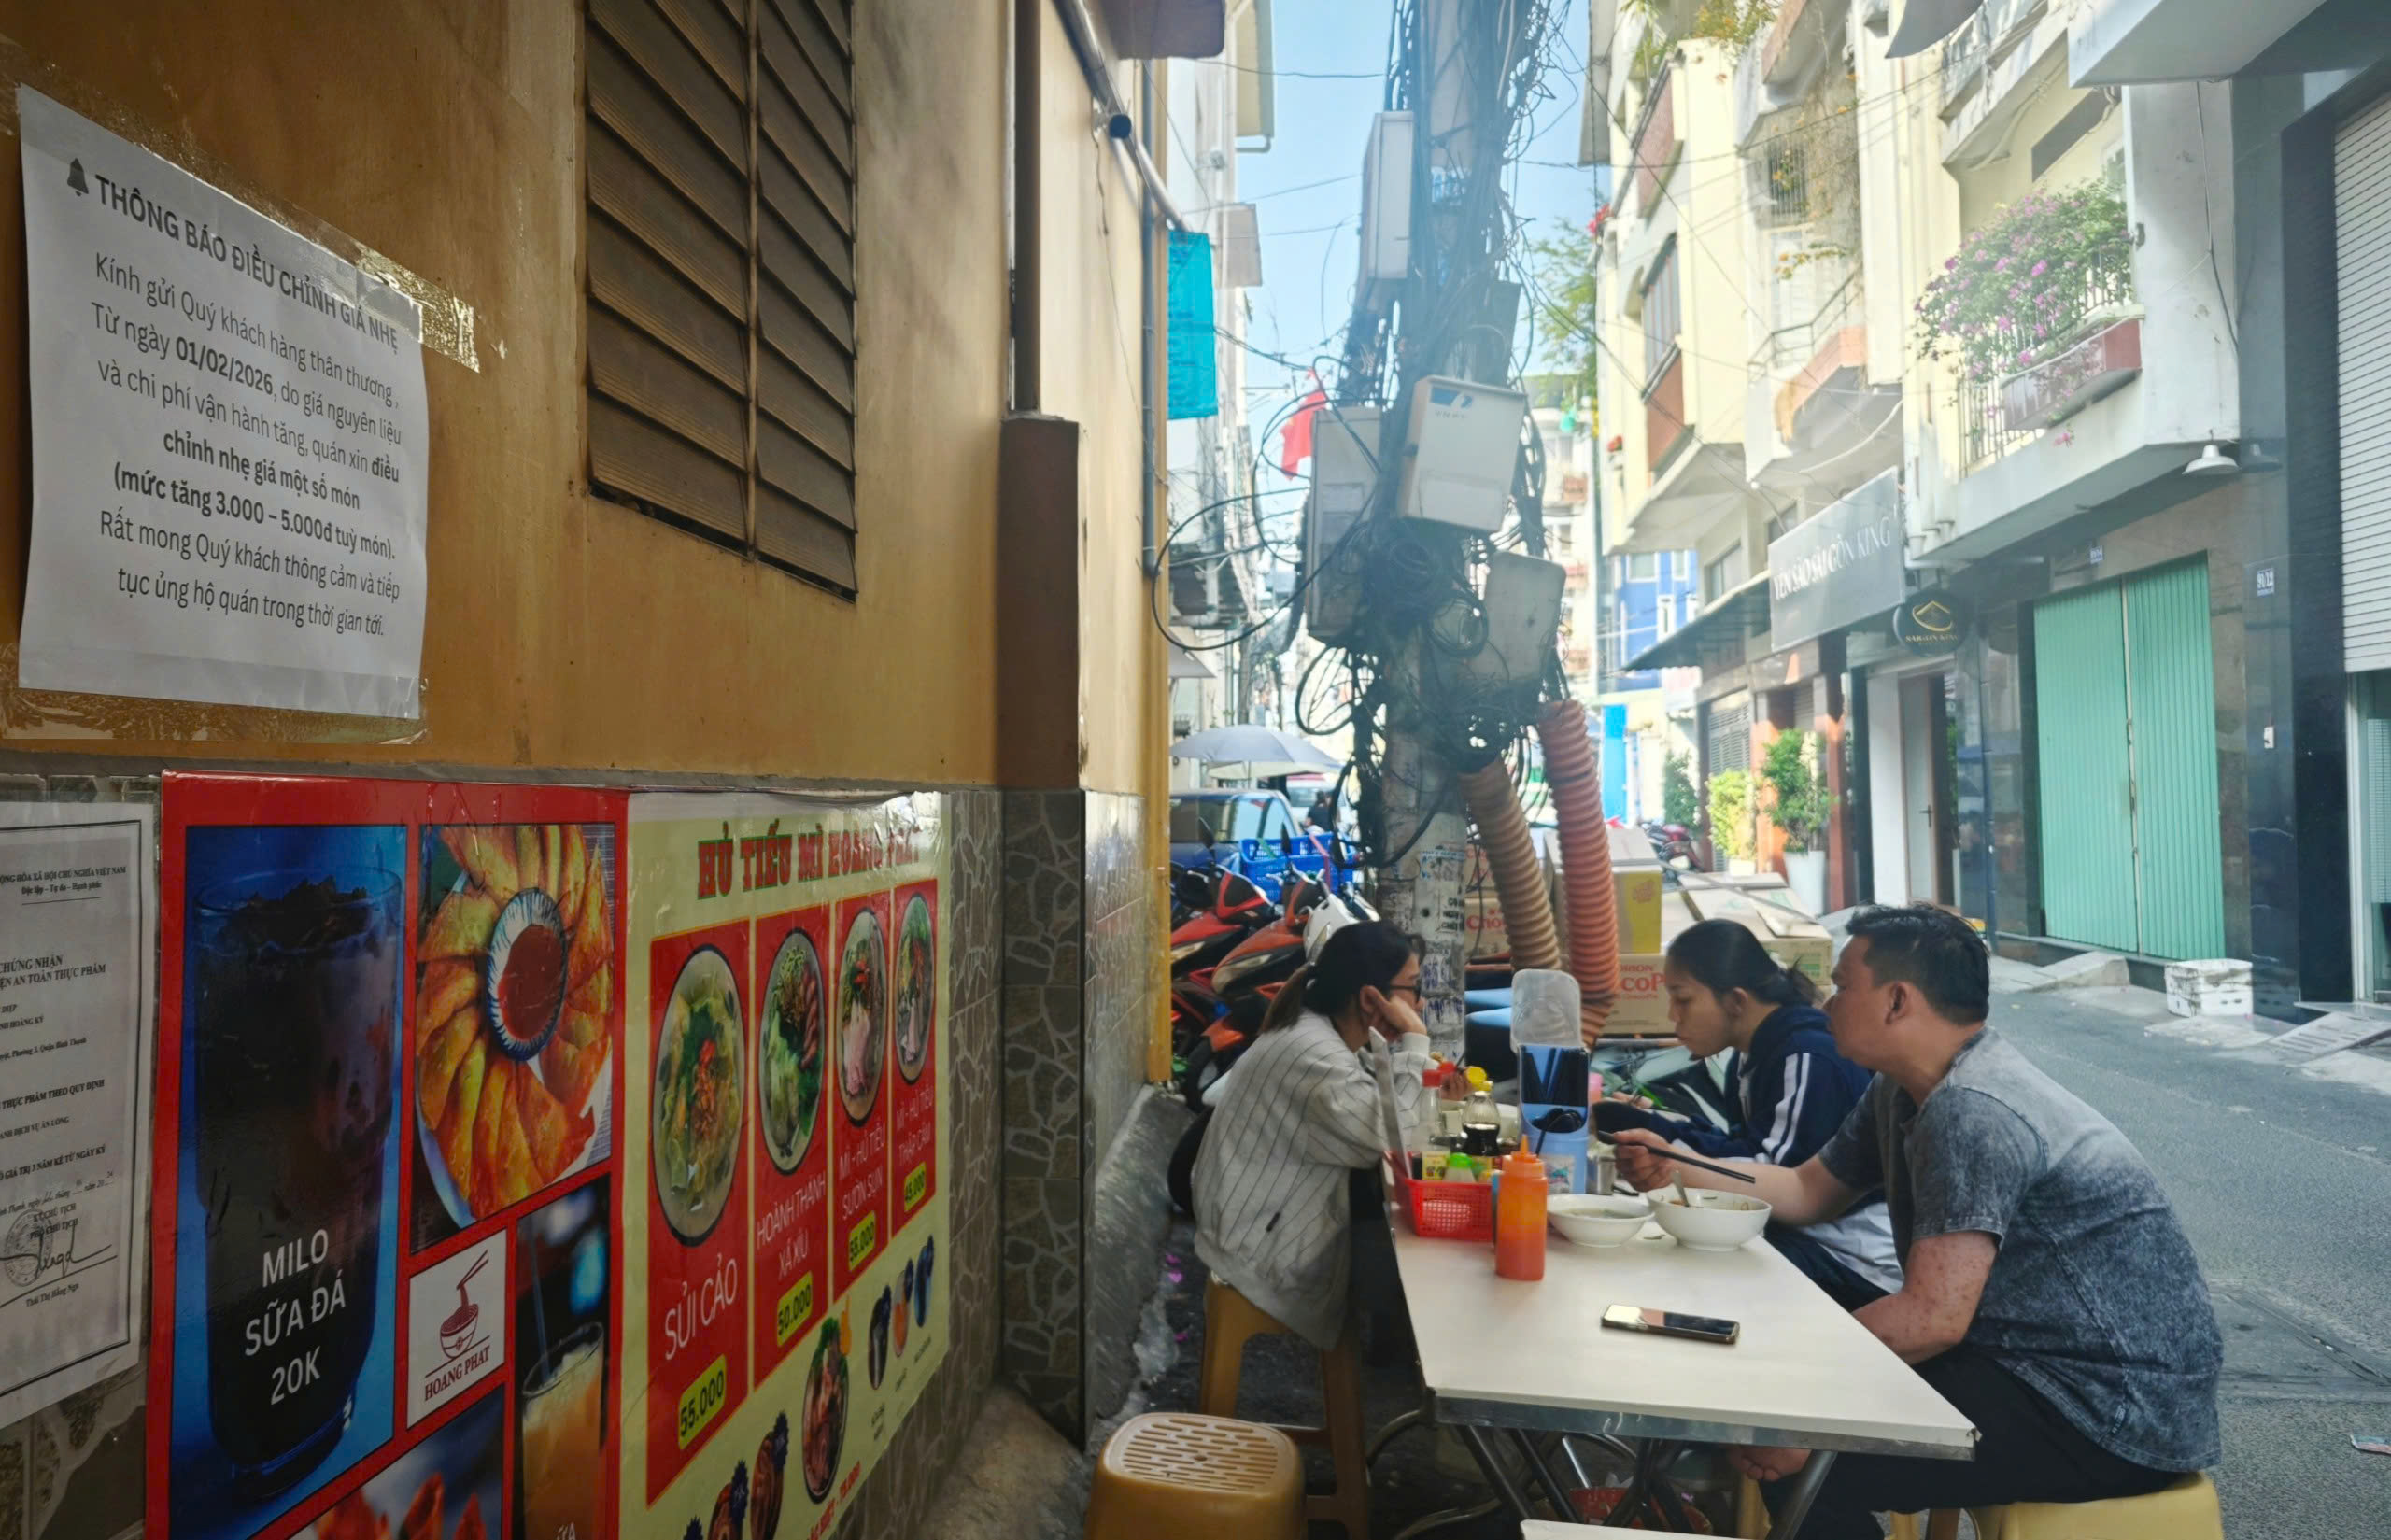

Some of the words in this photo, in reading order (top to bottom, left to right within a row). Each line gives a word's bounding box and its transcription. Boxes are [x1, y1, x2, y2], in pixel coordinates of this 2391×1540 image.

[95, 174, 179, 240] THÔNG
[185, 219, 226, 262] BÁO
[232, 244, 274, 287] ĐIỀU
[280, 271, 336, 318] CHỈNH
[340, 303, 366, 334] GIÁ
[369, 316, 398, 355] NHẸ
[96, 252, 140, 294] Kính
[147, 277, 175, 307] gửi
[181, 291, 216, 331] Quý
[221, 306, 265, 349] khách
[270, 330, 306, 372] hàng
[310, 351, 342, 381] thân
[91, 302, 120, 334] Từ
[125, 321, 170, 360] ngày
[176, 337, 277, 402] 01/02/2026,
[281, 381, 299, 406] do
[304, 391, 323, 417] giá
[328, 403, 375, 435] nguyên
[379, 418, 401, 445] liệu
[98, 359, 121, 387] và
[127, 369, 155, 398] chi
[162, 381, 191, 410] phí
[195, 393, 226, 423] vận
[232, 403, 269, 438] hành
[274, 421, 308, 457] tăng,
[312, 439, 346, 465] quán
[349, 450, 368, 473] xin
[372, 454, 399, 483] điều
[163, 429, 214, 465] chỉnh
[219, 447, 250, 481] nhẹ
[254, 459, 276, 486] giá
[280, 469, 309, 497] một
[312, 473, 327, 500] số
[332, 487, 360, 510] món
[115, 462, 166, 499] (mức
[171, 480, 212, 517] tăng
[216, 491, 263, 524] 3.000
[281, 509, 332, 543] 5.000đ
[361, 535, 395, 560] món).
[101, 506, 134, 542] Rất
[140, 525, 191, 560] mong
[196, 533, 231, 568] Quý
[235, 541, 280, 572] khách
[285, 555, 326, 588] thông
[330, 563, 357, 590] cảm
[361, 572, 374, 595] và
[377, 572, 400, 604] tiếp
[118, 568, 149, 599] tục
[155, 571, 189, 609] ủng
[193, 579, 214, 611] hộ
[219, 589, 259, 615] quán
[263, 595, 304, 628] trong
[308, 602, 334, 627] thời
[336, 608, 361, 635] gian
[365, 614, 384, 636] tới.
[0, 874, 15, 884] ỘNG
[111, 866, 126, 875] NAM
[698, 821, 733, 900] HỦ
[741, 818, 792, 893] TIẾU
[798, 823, 824, 883] MÌ
[28, 969, 52, 983] TOÀN
[54, 967, 79, 981] THỰC
[80, 963, 106, 977] PHẨM
[35, 954, 63, 969] NHẬN
[49, 1087, 68, 1099] THEO
[69, 1083, 85, 1095] QUY
[262, 1228, 328, 1288] MILO
[245, 1299, 304, 1357] SỮA
[311, 1269, 346, 1323] ĐÁ
[664, 1280, 696, 1361] SỦI
[700, 1252, 738, 1326] CẢO
[271, 1346, 320, 1406] 20K
[424, 1363, 462, 1402] HOANG
[464, 1345, 490, 1376] PHAT
[680, 1369, 724, 1437] 55.000
